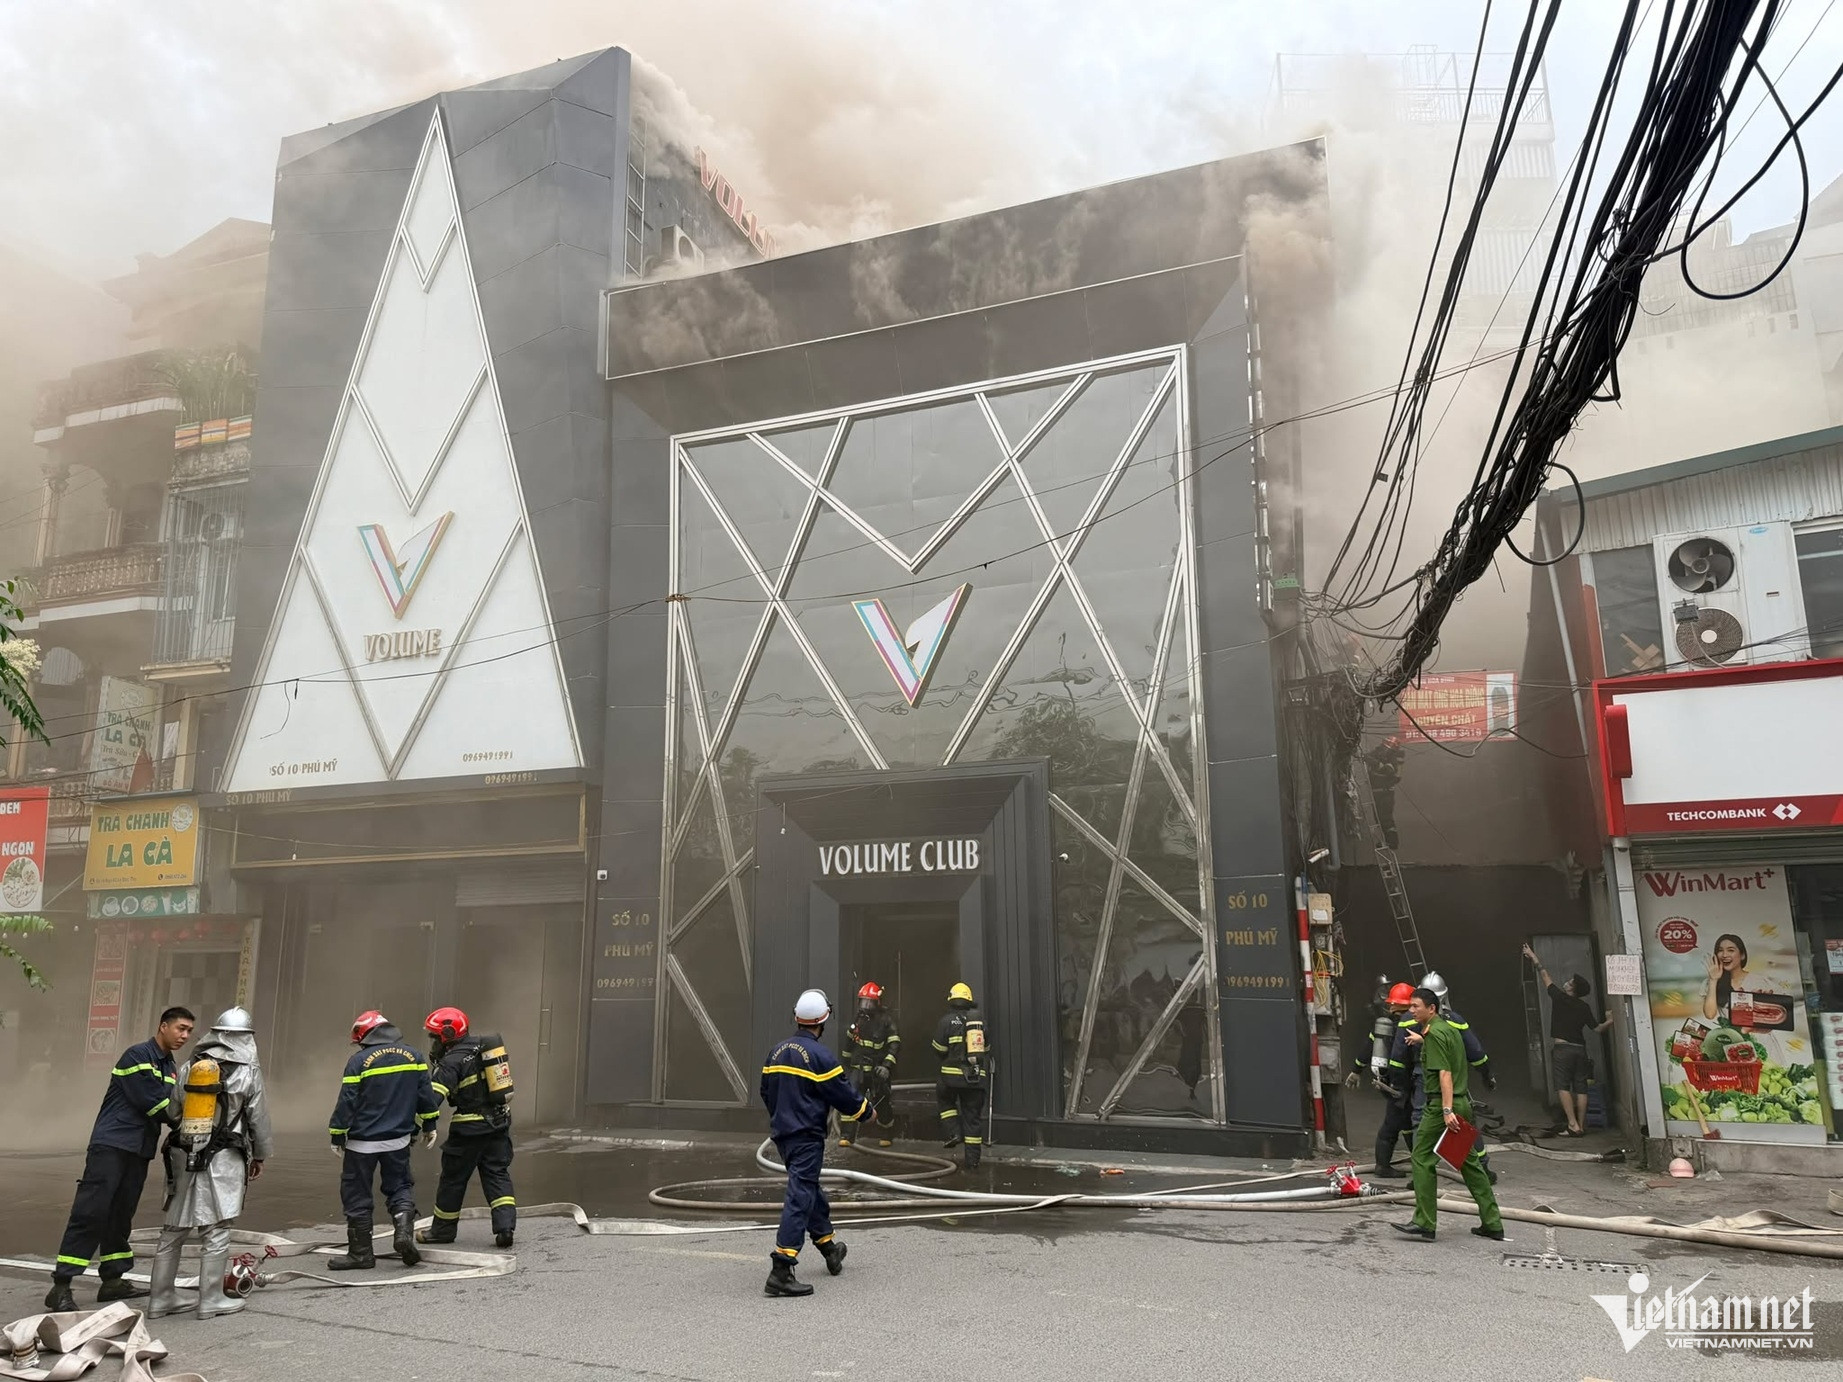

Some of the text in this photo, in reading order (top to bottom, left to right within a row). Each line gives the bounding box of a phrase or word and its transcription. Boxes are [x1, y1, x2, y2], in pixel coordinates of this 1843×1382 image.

[363, 629, 441, 662] VOLUME
[270, 762, 285, 776] SỐ
[288, 764, 299, 775] 10
[302, 760, 320, 773] PHÚ
[126, 812, 170, 831] CHANH
[1667, 808, 1767, 821] TECHCOMBANK
[2, 841, 34, 856] NGON
[106, 835, 173, 868] LA CÀ
[819, 839, 980, 875] VOLUME CLUB
[1228, 890, 1268, 909] SỐ 10
[1226, 926, 1278, 945] PHÚ MỸ
[1663, 929, 1692, 940] 20%
